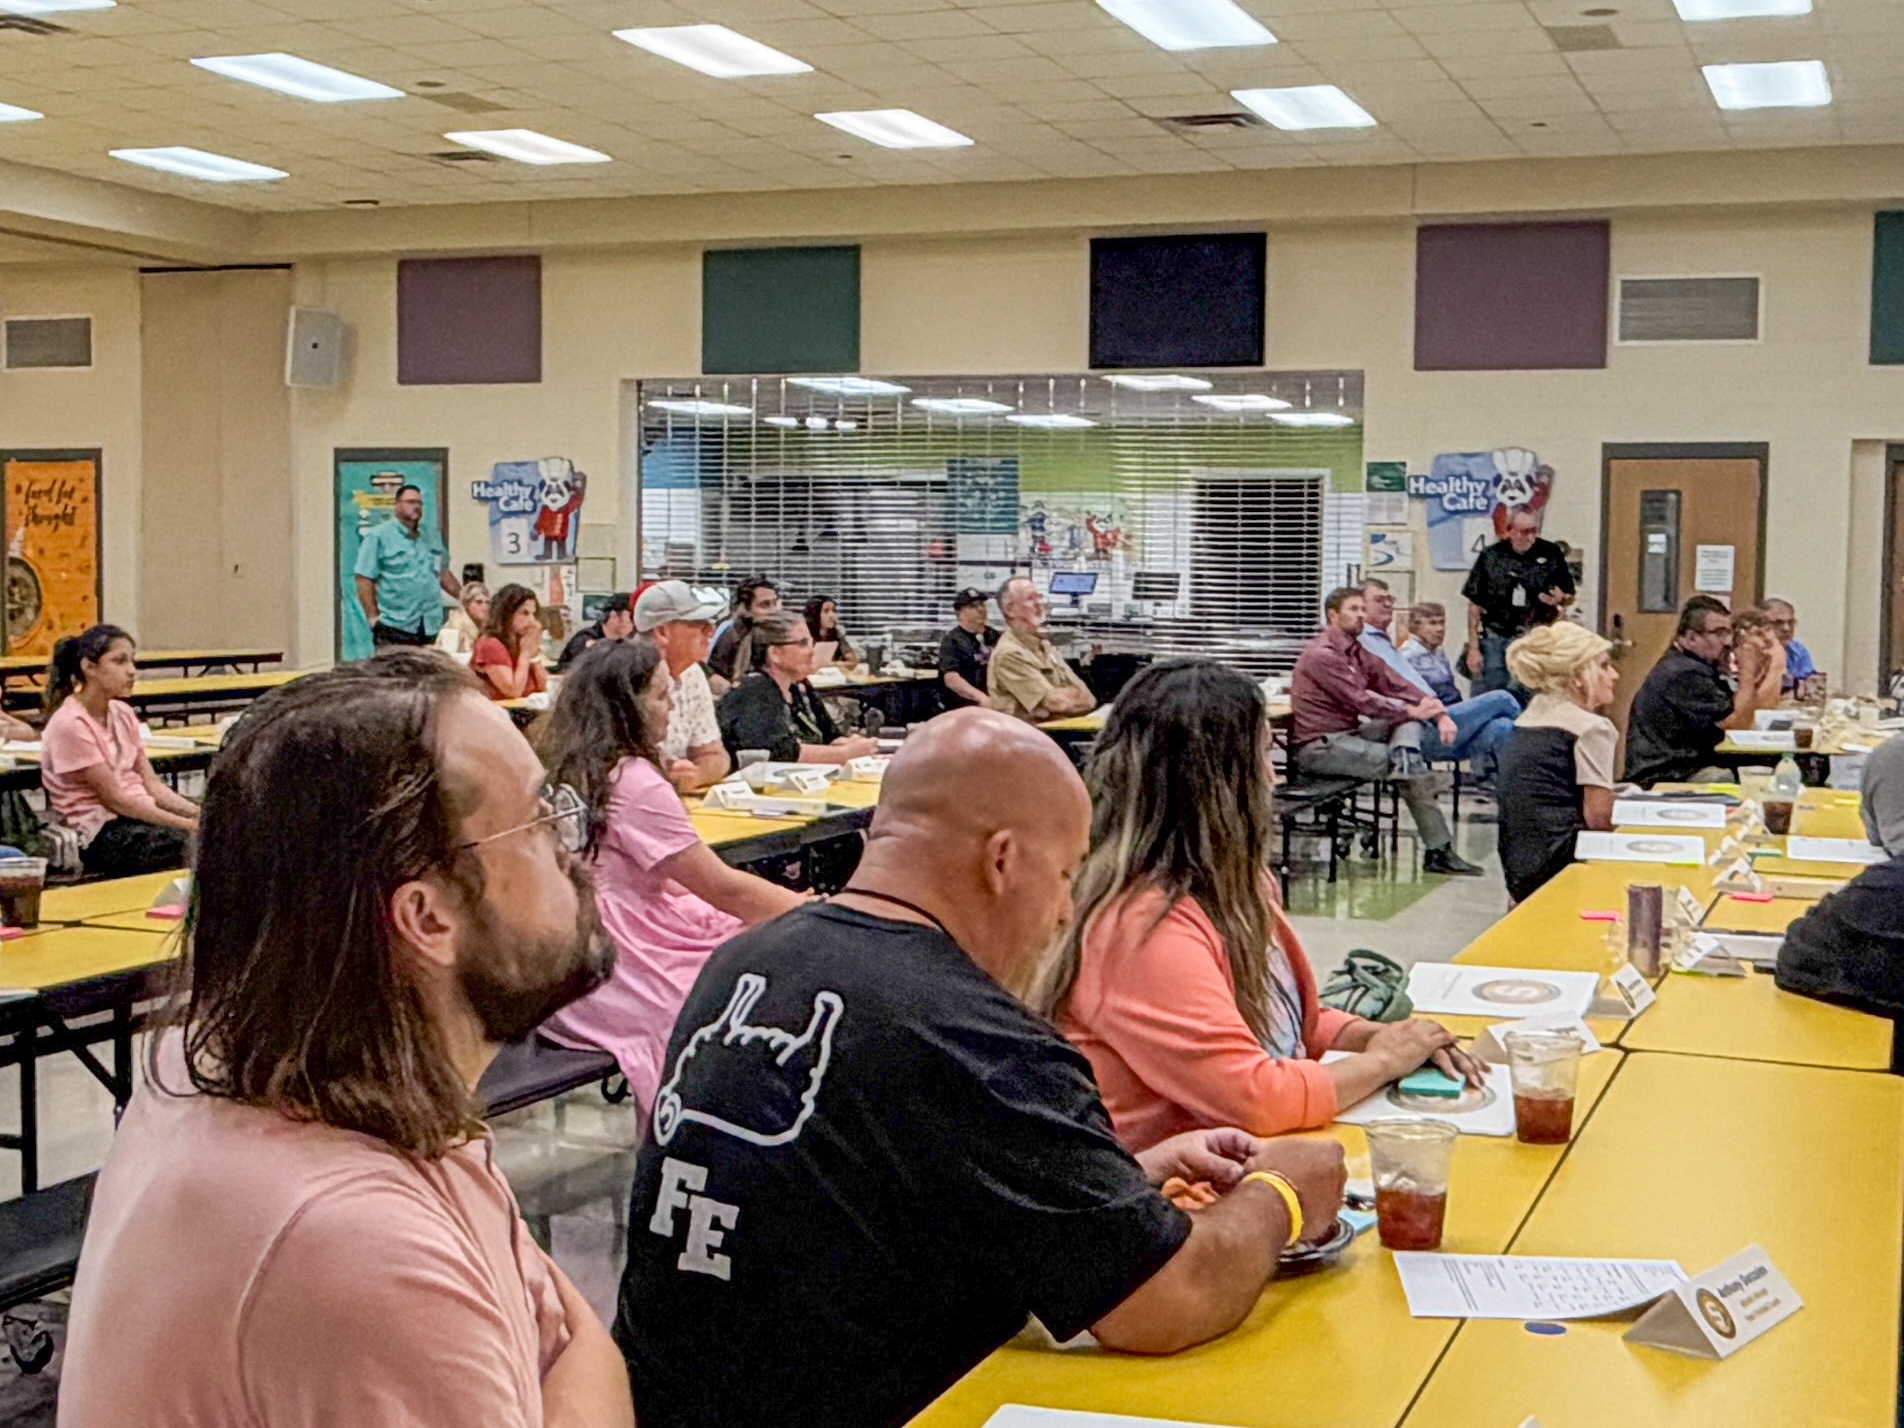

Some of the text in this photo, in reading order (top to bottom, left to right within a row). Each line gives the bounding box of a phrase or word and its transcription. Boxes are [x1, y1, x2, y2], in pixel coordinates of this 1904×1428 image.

[472, 481, 535, 500] Healthy
[1409, 475, 1487, 496] Healthy
[1442, 493, 1490, 511] Cafe
[507, 532, 521, 554] 3
[1471, 533, 1486, 553] 4
